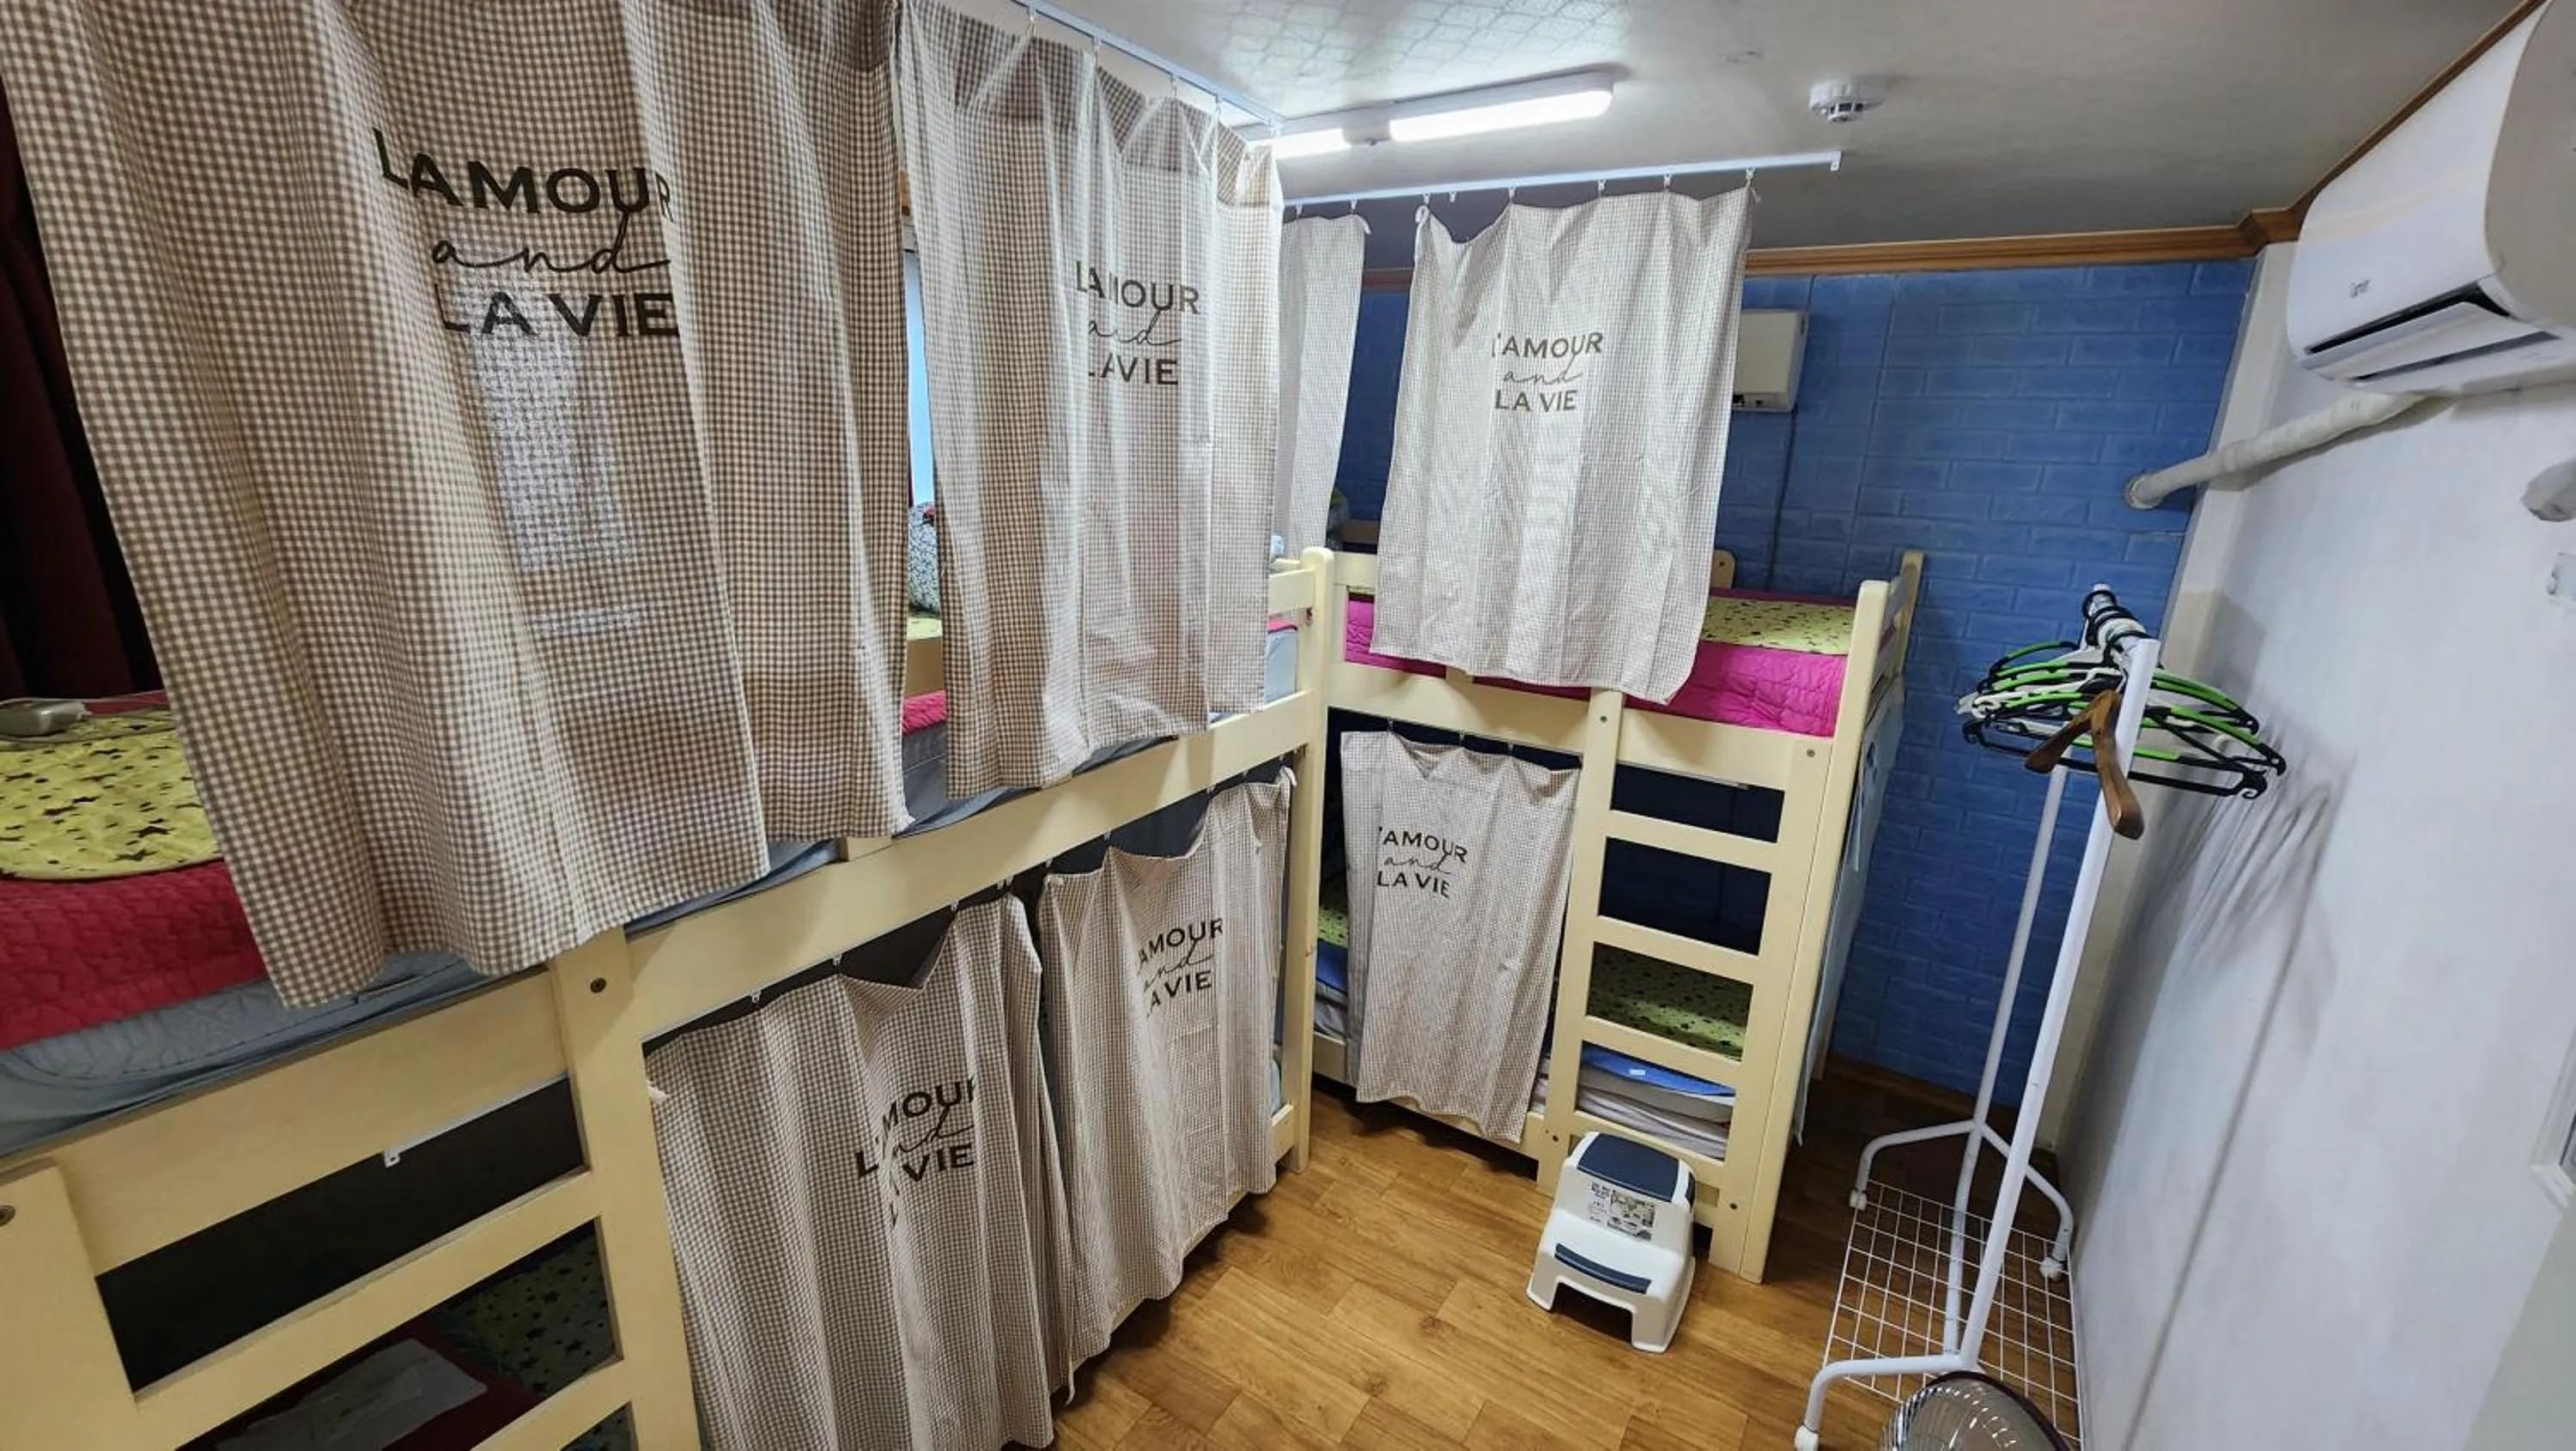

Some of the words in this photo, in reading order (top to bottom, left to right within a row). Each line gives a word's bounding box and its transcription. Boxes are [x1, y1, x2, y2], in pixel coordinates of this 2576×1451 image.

[432, 209, 671, 275] and
[434, 283, 538, 336] LA
[549, 292, 681, 338] VIE
[1117, 355, 1179, 386] VIE
[1504, 355, 1584, 386] and
[1495, 389, 1532, 413] LA
[1540, 389, 1578, 413] VIE
[1383, 853, 1453, 875] and
[1376, 870, 1408, 888] LA
[1414, 872, 1451, 900] VIE
[1164, 969, 1212, 999] VIE
[902, 1143, 975, 1182] VIE
